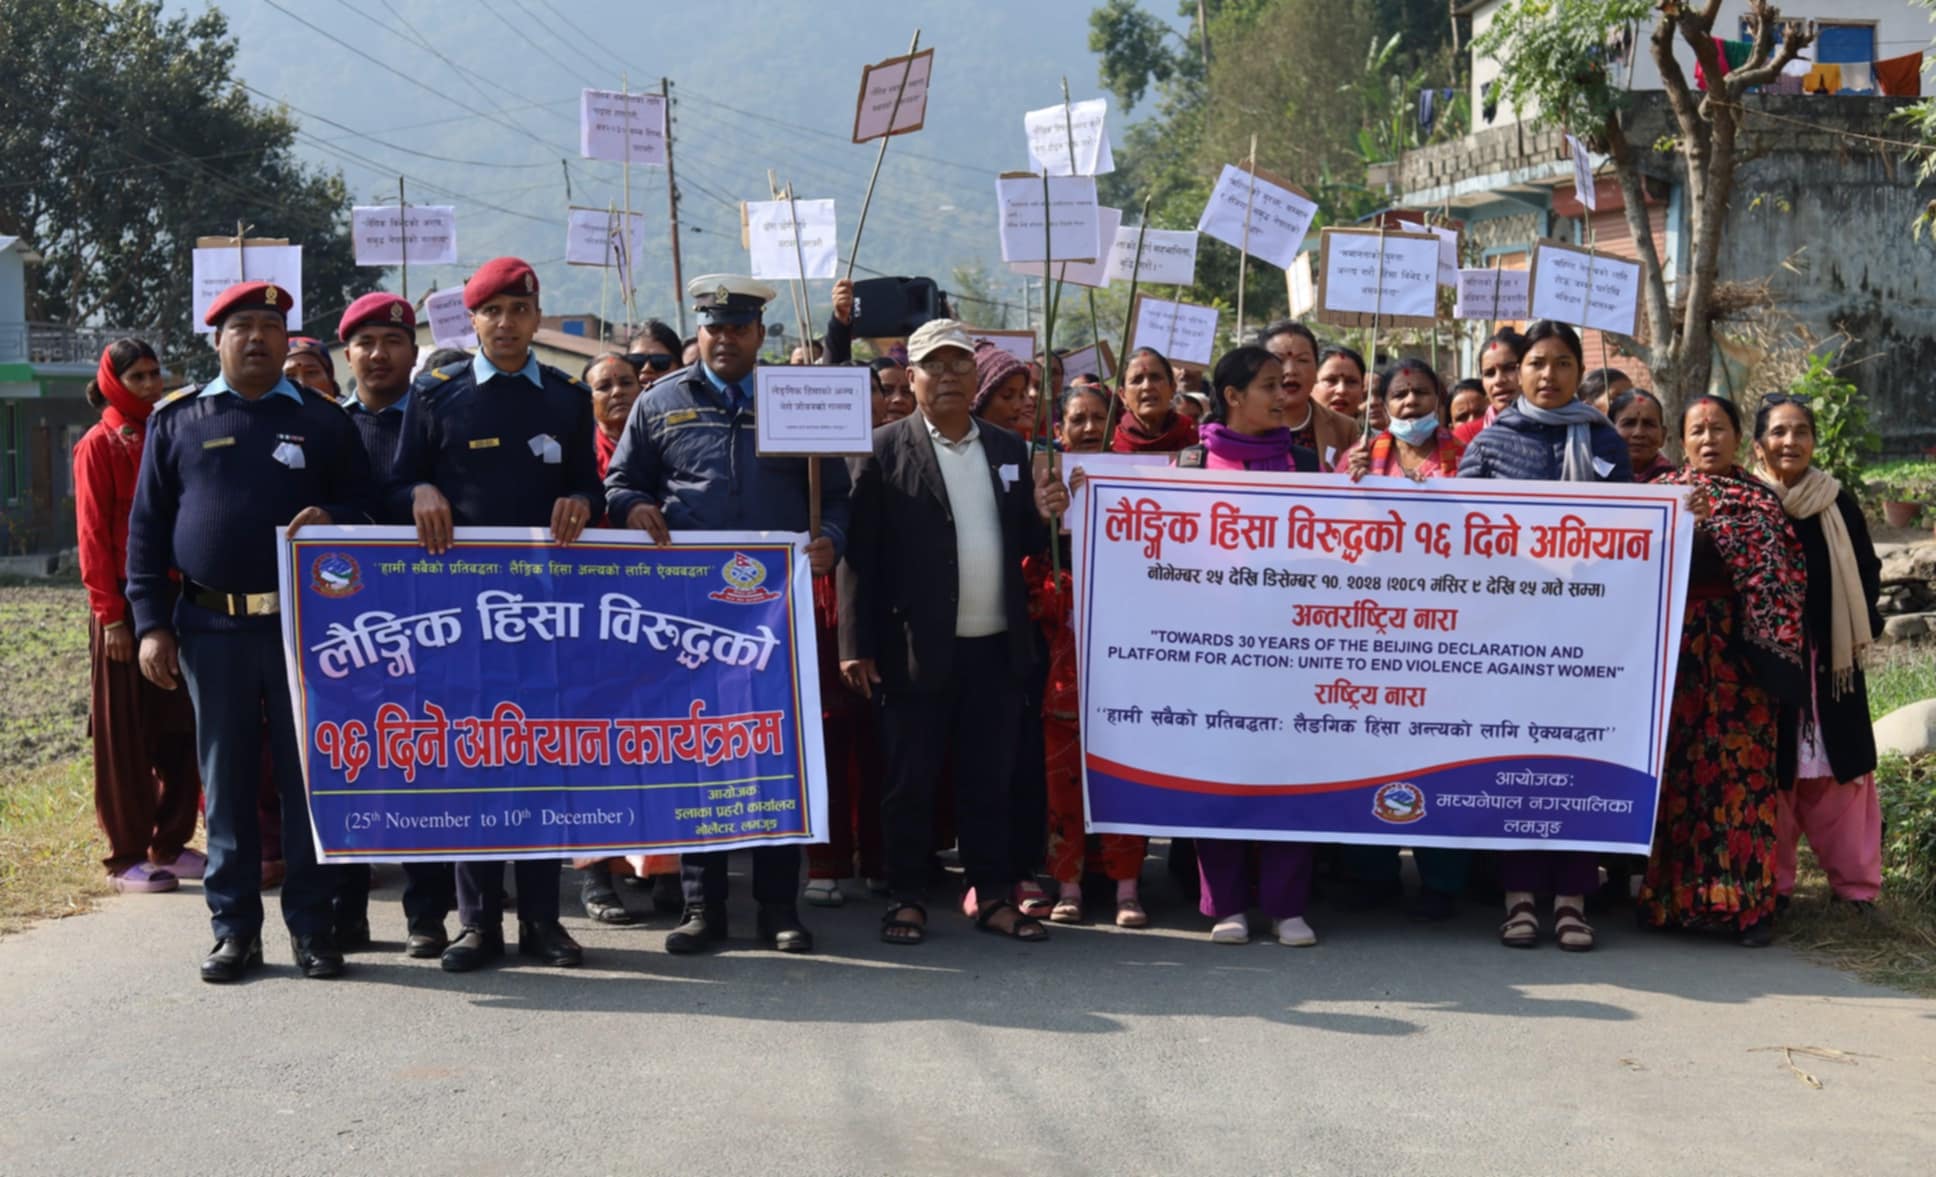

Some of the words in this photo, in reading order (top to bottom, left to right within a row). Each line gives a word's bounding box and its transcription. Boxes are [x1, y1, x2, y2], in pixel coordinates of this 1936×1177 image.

[1105, 496, 1201, 561] लैङ्गिक
[1210, 501, 1279, 551] हिंसा
[1414, 521, 1452, 559] १६
[1464, 511, 1521, 560] दिने
[1529, 514, 1653, 561] अभियान
[1206, 570, 1224, 585] २५
[1229, 566, 1258, 587] देखि
[1263, 567, 1317, 589] डिसेम्बर
[1347, 575, 1382, 591] २०२४
[1430, 573, 1469, 595] मंसिर
[1486, 575, 1516, 596] देखि
[1519, 580, 1537, 596] २५
[1541, 577, 1564, 597] गते
[311, 608, 463, 679] लैङ्गिक
[476, 589, 585, 643] हिंसा
[1413, 607, 1459, 632] नारा
[1150, 630, 1234, 648] "TOWARDS
[1238, 636, 1255, 649] 30
[1257, 636, 1310, 650] YEARS
[1314, 638, 1338, 652] OF
[1341, 639, 1369, 653] THE
[1373, 640, 1433, 655] BEIJING
[1437, 642, 1547, 658] DECLARATION
[1550, 646, 1584, 660] AND
[1108, 646, 1191, 664] PLATFORM
[1195, 651, 1227, 666] FOR
[1230, 653, 1294, 669] ACTION:
[1298, 656, 1343, 670] UNITE
[1347, 658, 1367, 672] TO
[1371, 658, 1403, 673] END
[1406, 660, 1483, 676] VIOLENCE
[1487, 662, 1556, 678] AGAINST
[1314, 677, 1379, 710] राष्ट्रिय
[1384, 685, 1428, 708] नारा
[1151, 704, 1198, 727] सबैको
[1365, 714, 1400, 738] हिंसा
[1480, 718, 1520, 740] लागि
[315, 719, 371, 783] १६
[374, 700, 450, 783] दिने
[454, 702, 612, 767] अभियान
[615, 699, 785, 767] कार्यक्रम
[1495, 767, 1575, 788] आयोजक:
[674, 806, 713, 821] इलाका
[716, 801, 744, 818] प्रहरी
[747, 797, 796, 814] कार्यालय
[1435, 790, 1523, 810] मध्यनेपाल
[1528, 793, 1635, 815] नगरपालिका
[385, 811, 471, 829] November
[481, 812, 497, 828] to
[503, 809, 532, 828] 10th
[541, 808, 623, 827] December
[1503, 818, 1563, 838] लमजुङ
